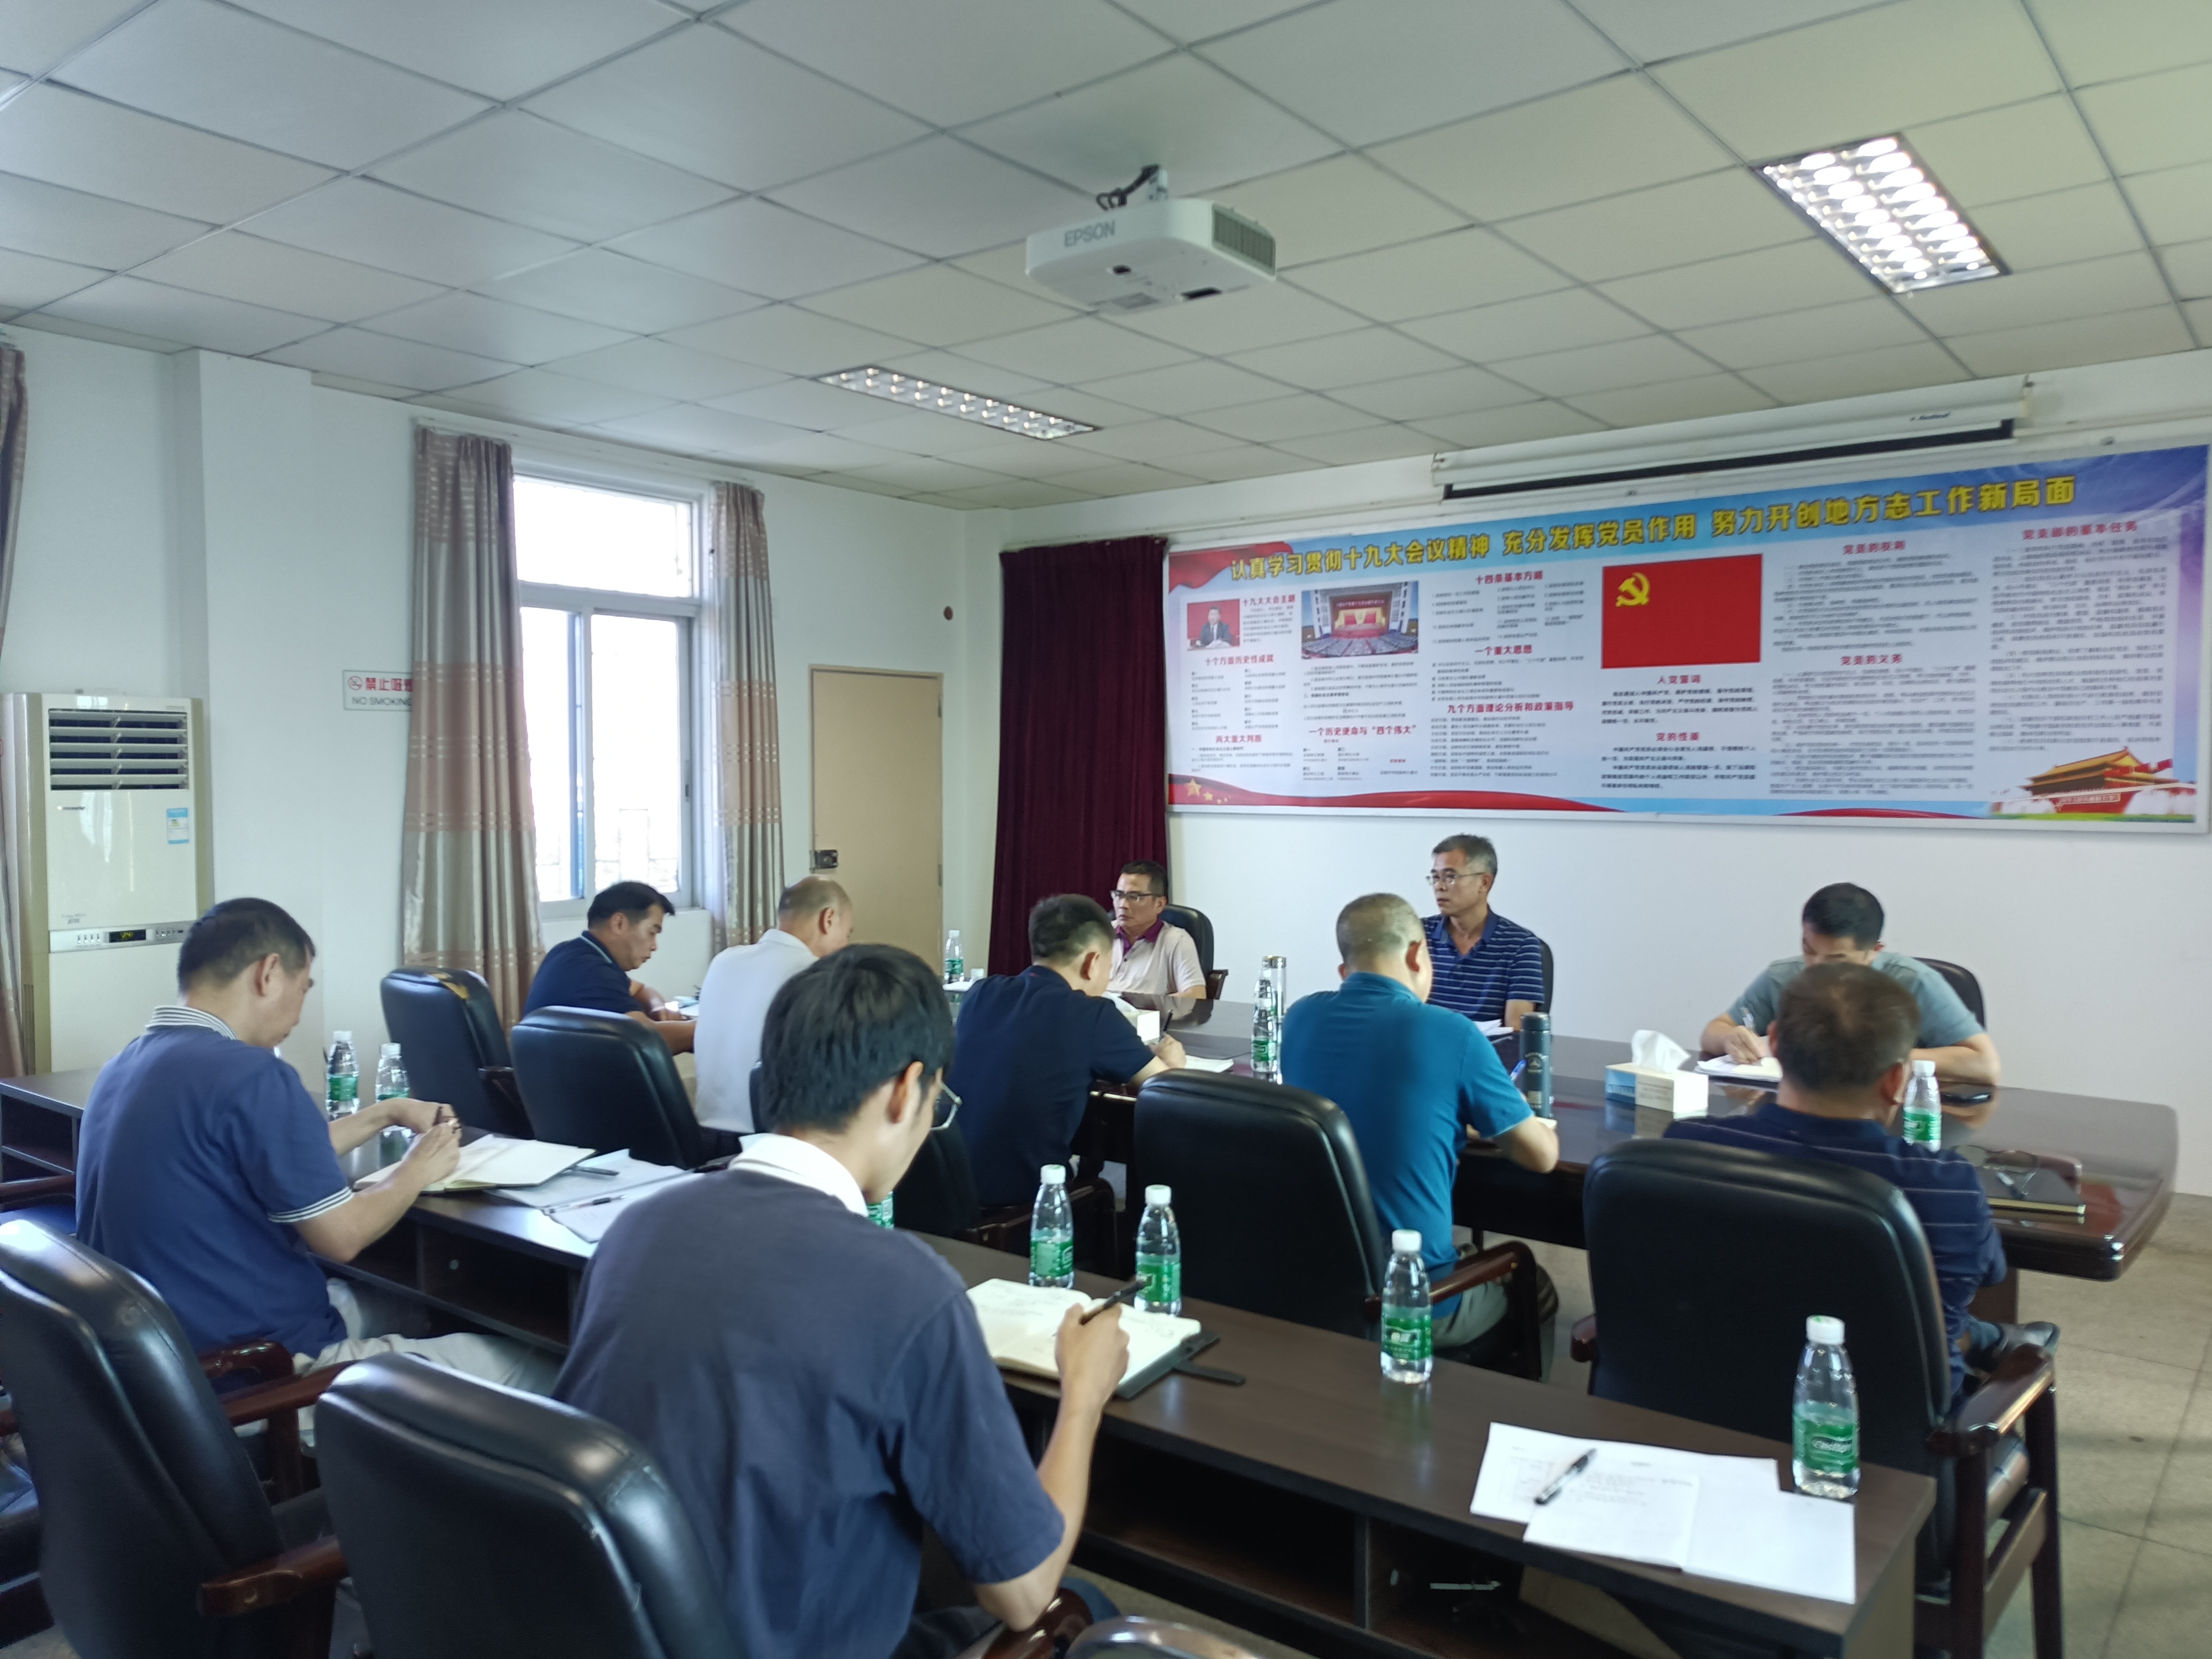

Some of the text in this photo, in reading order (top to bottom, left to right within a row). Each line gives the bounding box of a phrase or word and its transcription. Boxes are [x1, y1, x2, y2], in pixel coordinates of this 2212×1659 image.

[1065, 221, 1115, 248] EPSON
[1230, 474, 2075, 581] 认真学习贯彻十九大会议精神 充分发挥党员作用 努力开创地方志工作新局面
[1474, 644, 1533, 656] 一个重大思想
[352, 697, 367, 705] NO
